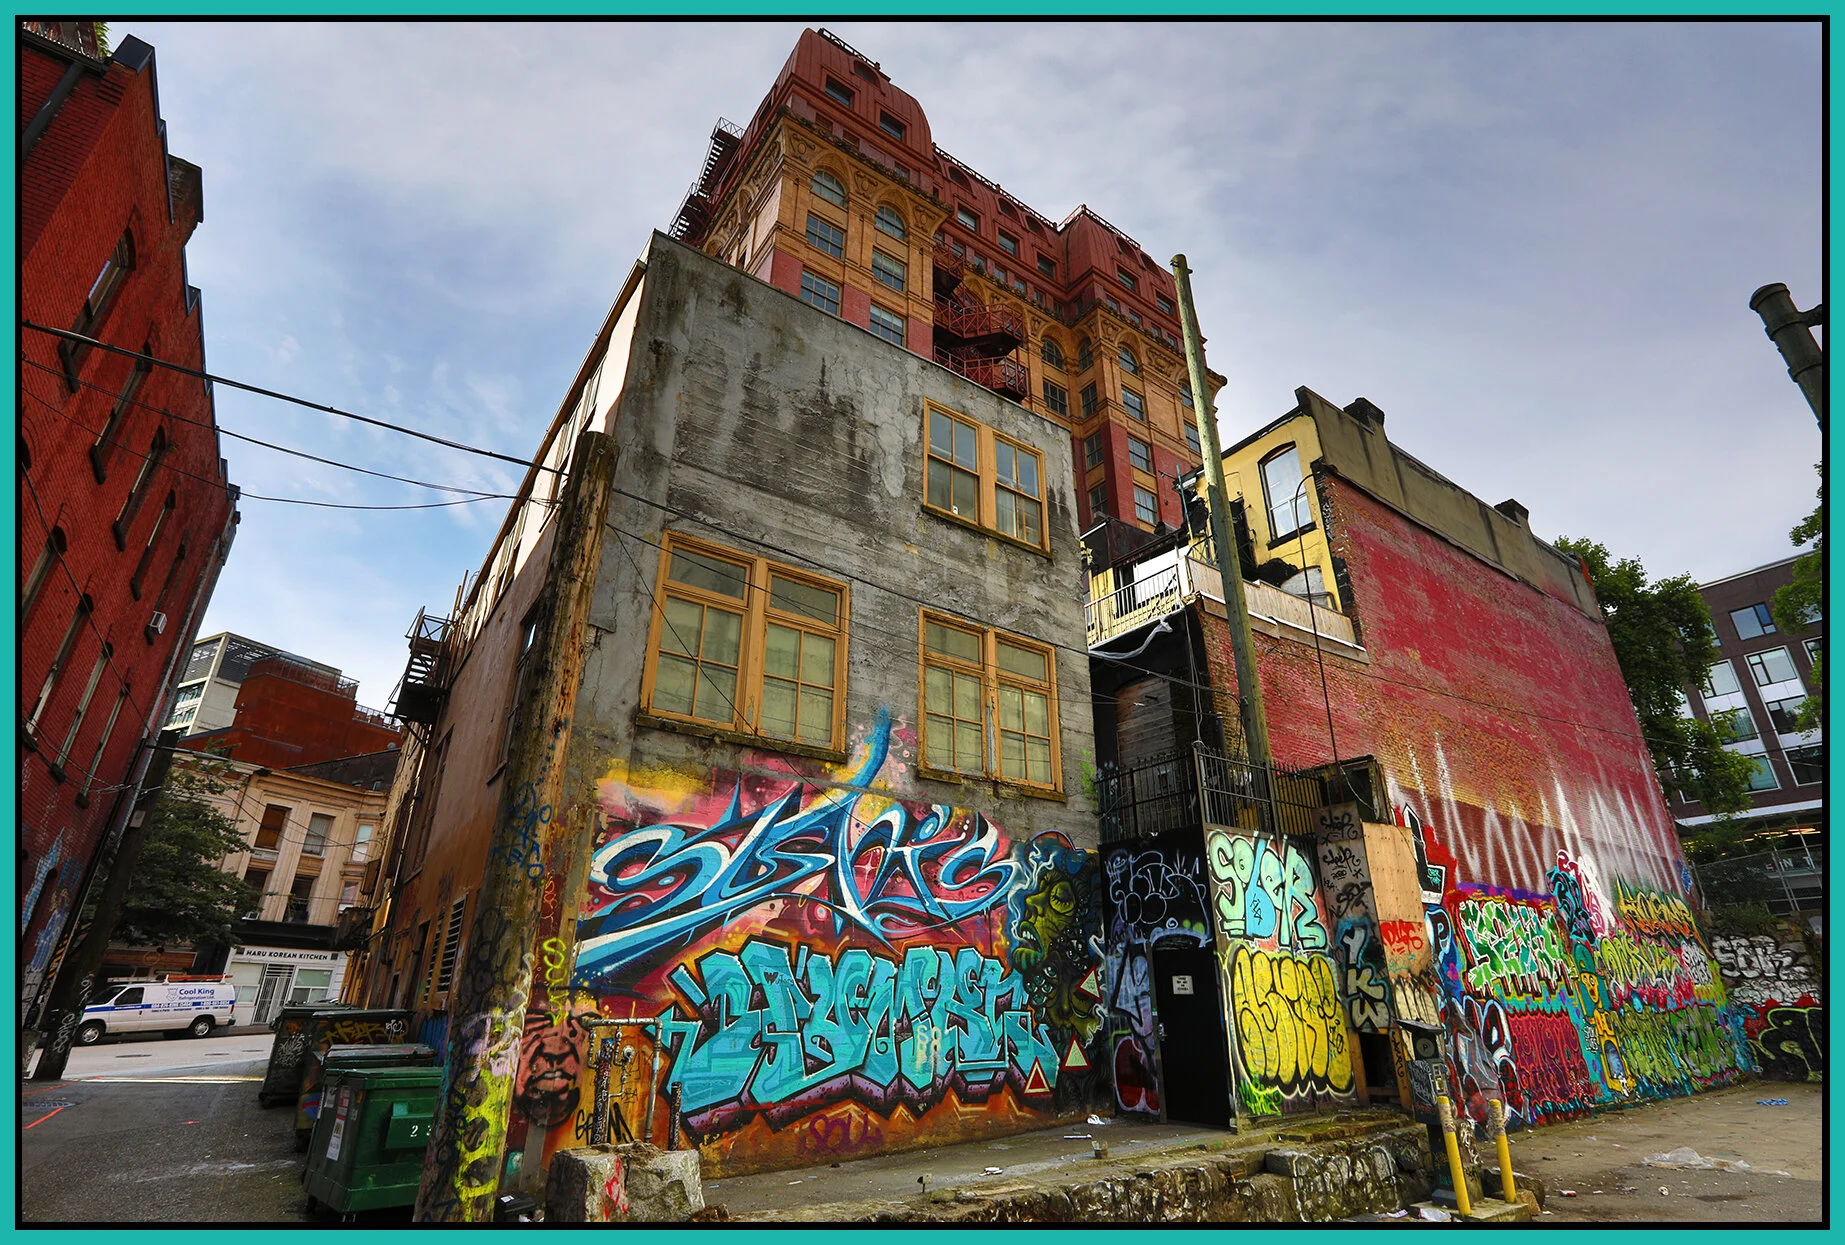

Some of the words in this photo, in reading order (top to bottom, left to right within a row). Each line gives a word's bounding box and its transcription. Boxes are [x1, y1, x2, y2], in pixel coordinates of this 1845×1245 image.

[268, 951, 297, 959] KOREAN
[197, 987, 215, 996] King
[410, 1124, 419, 1138] 2
